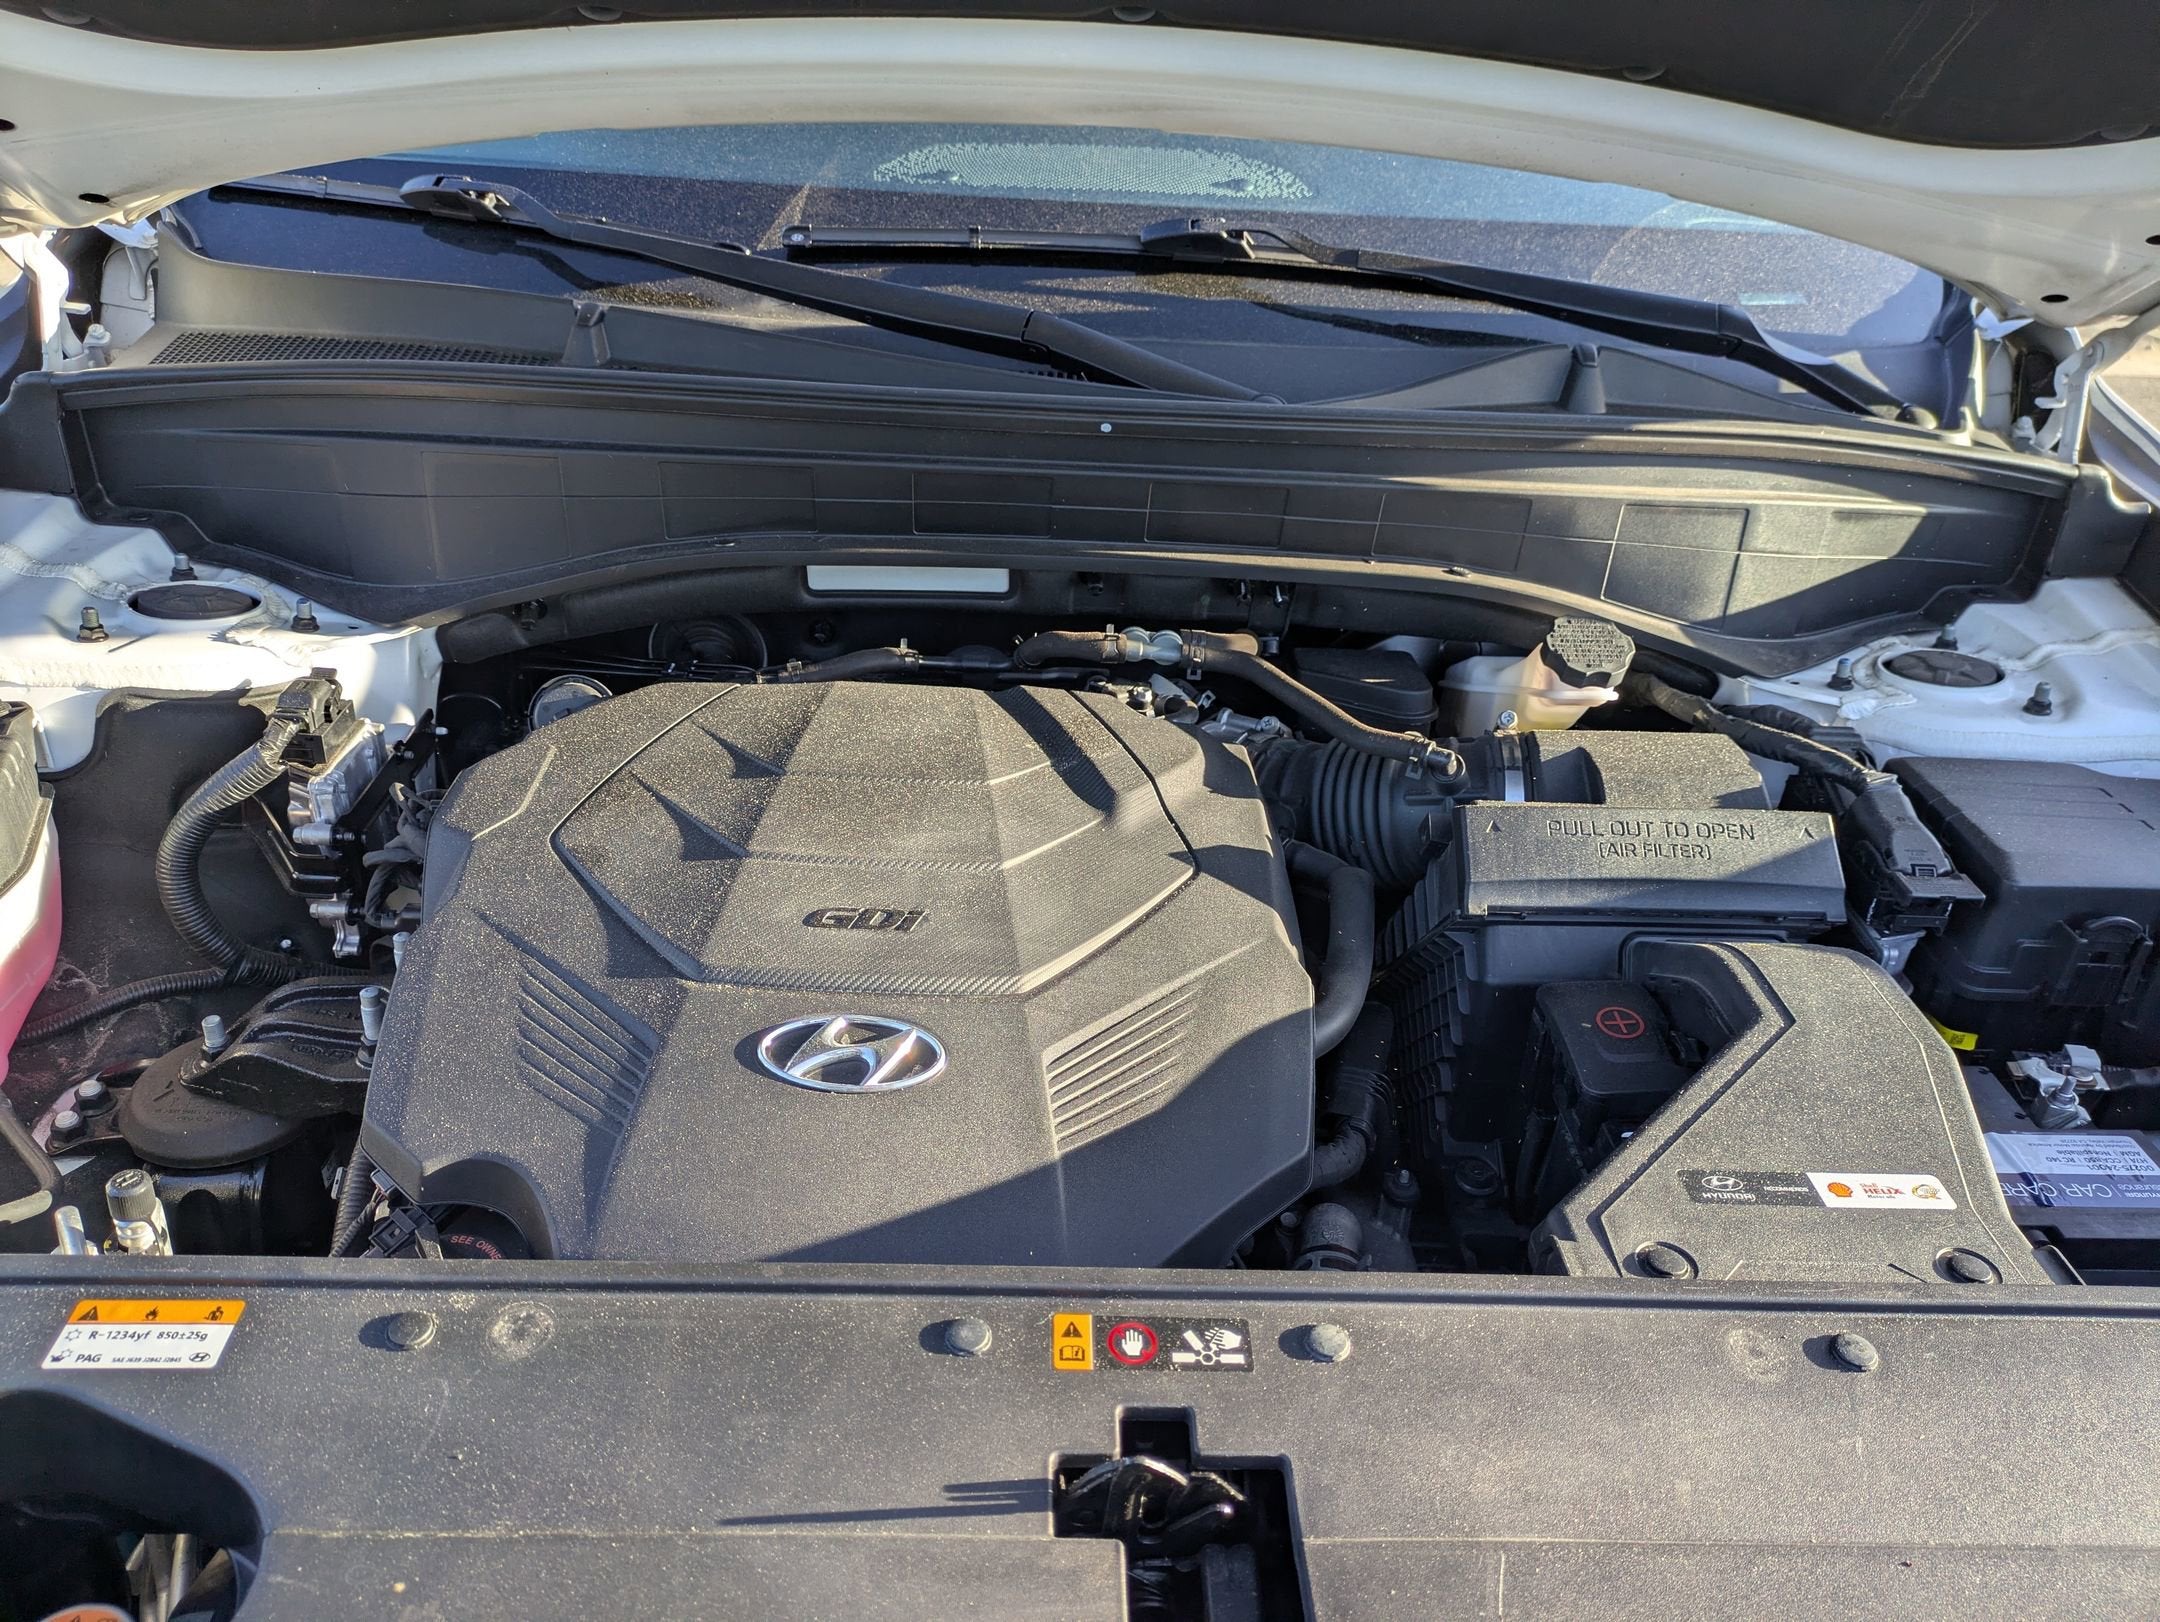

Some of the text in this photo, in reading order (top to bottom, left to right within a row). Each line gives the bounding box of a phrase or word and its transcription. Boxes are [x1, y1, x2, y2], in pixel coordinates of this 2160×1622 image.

[1547, 820, 1755, 840] PULL OUT TO OPEN
[2060, 1183, 2113, 1198] CAR
[1702, 1192, 1756, 1201] HYUNDAI
[450, 1235, 475, 1245] SEE
[88, 1330, 209, 1342] R-1234yf 850±25g
[75, 1353, 102, 1363] PAG
